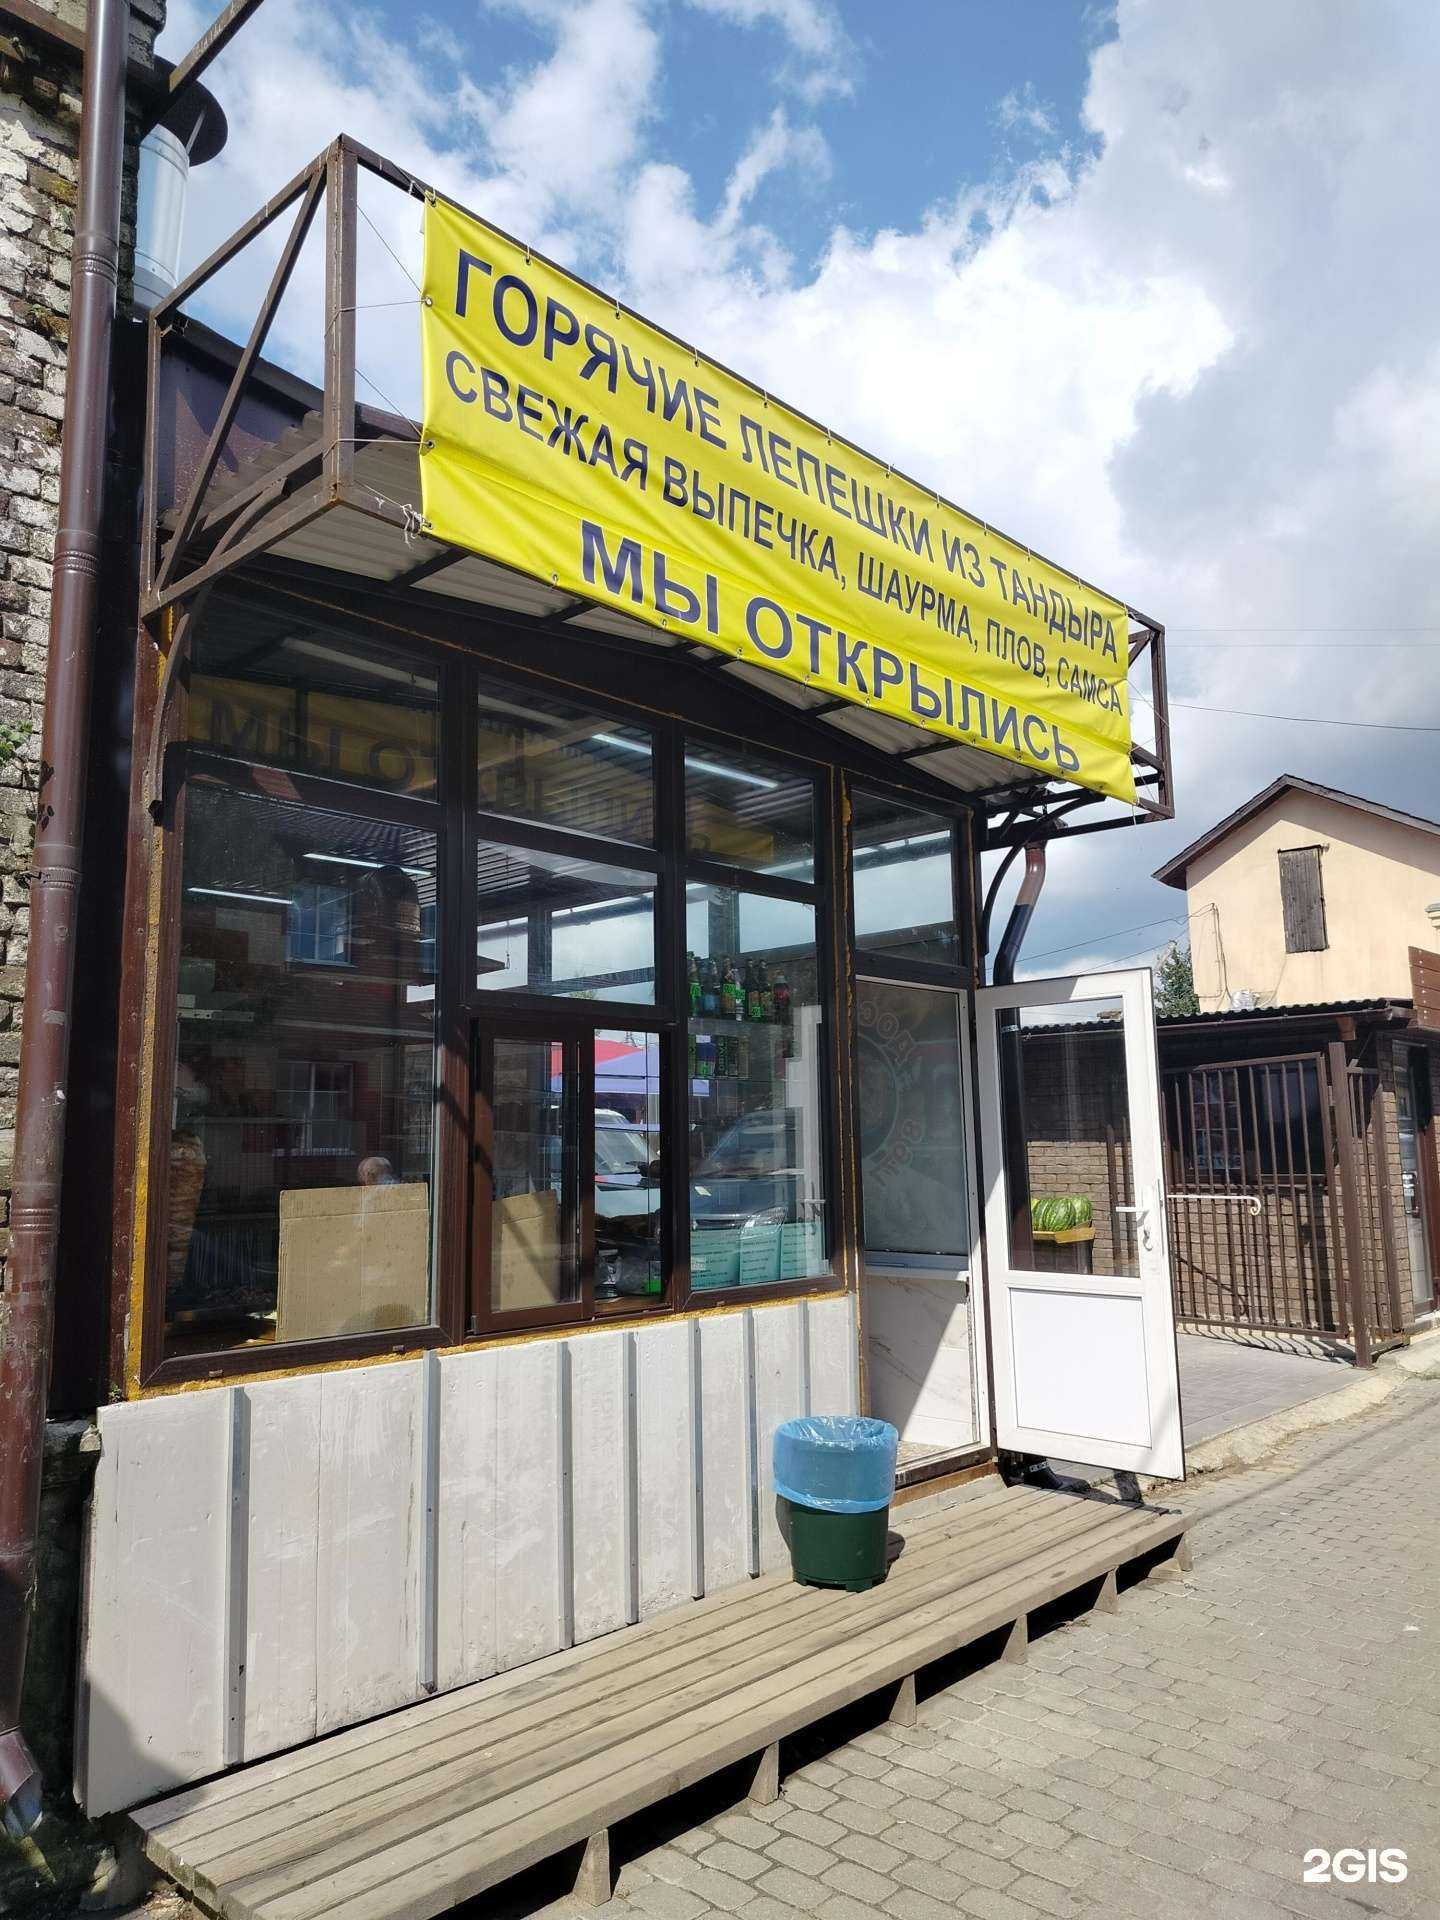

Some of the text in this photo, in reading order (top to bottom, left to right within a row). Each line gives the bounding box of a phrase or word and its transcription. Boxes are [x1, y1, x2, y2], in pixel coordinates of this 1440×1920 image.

[446, 351, 1123, 716] СВЕЖАЯ ВЫПЕЧКА, ШАУРМА, ПЛОВ, САМСА
[455, 248, 1117, 663] ГОРЯЧИЕ ЛЕПЕШКИ ИЗ ТАНДЫРА
[581, 519, 1080, 772] МЫ ОТКРЫЛИСЬ
